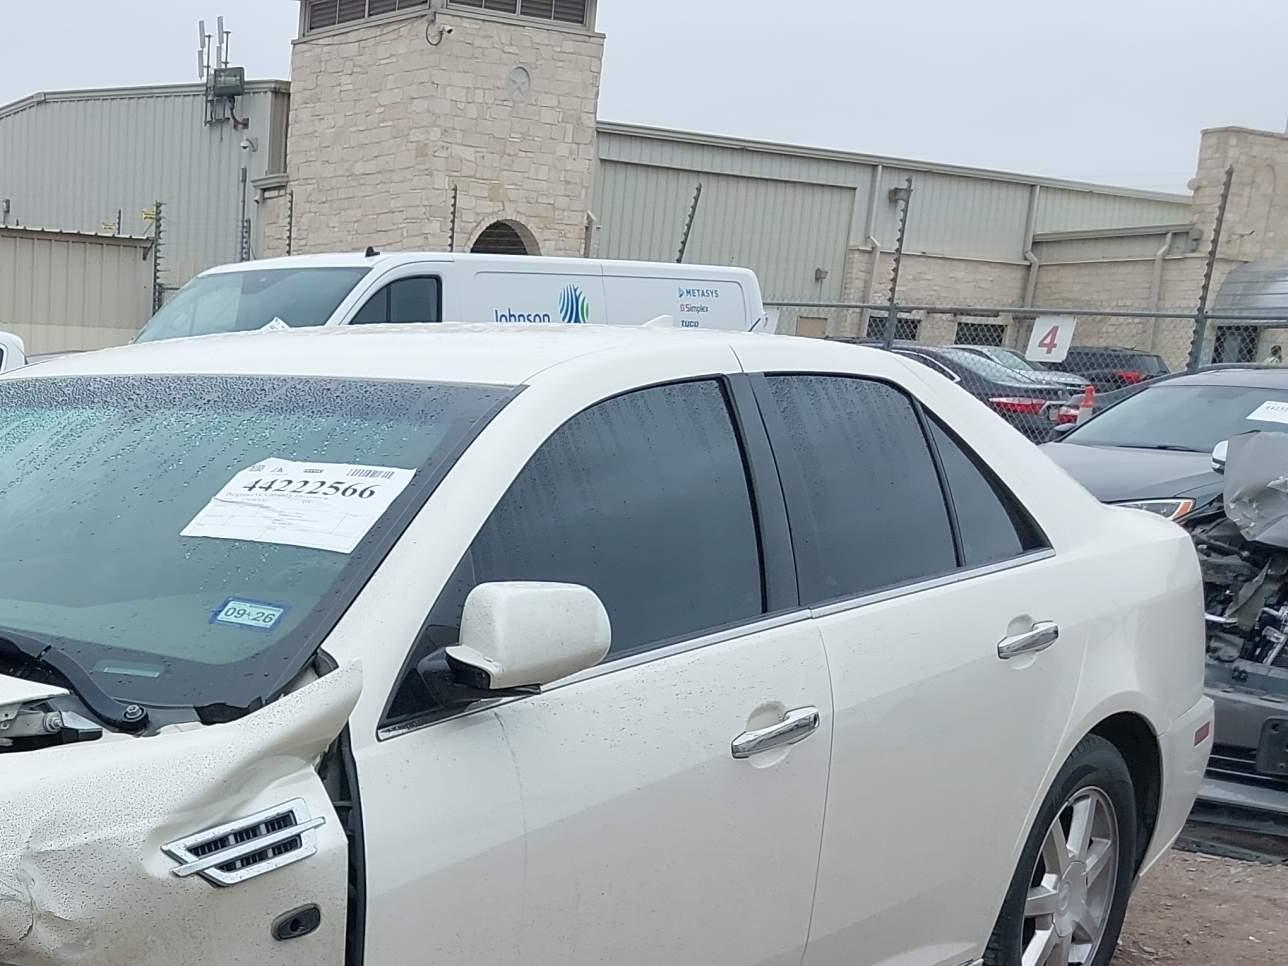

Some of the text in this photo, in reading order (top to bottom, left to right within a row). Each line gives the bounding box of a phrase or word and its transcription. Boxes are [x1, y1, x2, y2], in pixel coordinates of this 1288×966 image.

[685, 288, 719, 298] METASYS
[494, 307, 551, 323] Johnson
[1038, 325, 1060, 354] 4
[242, 478, 380, 499] 44222566
